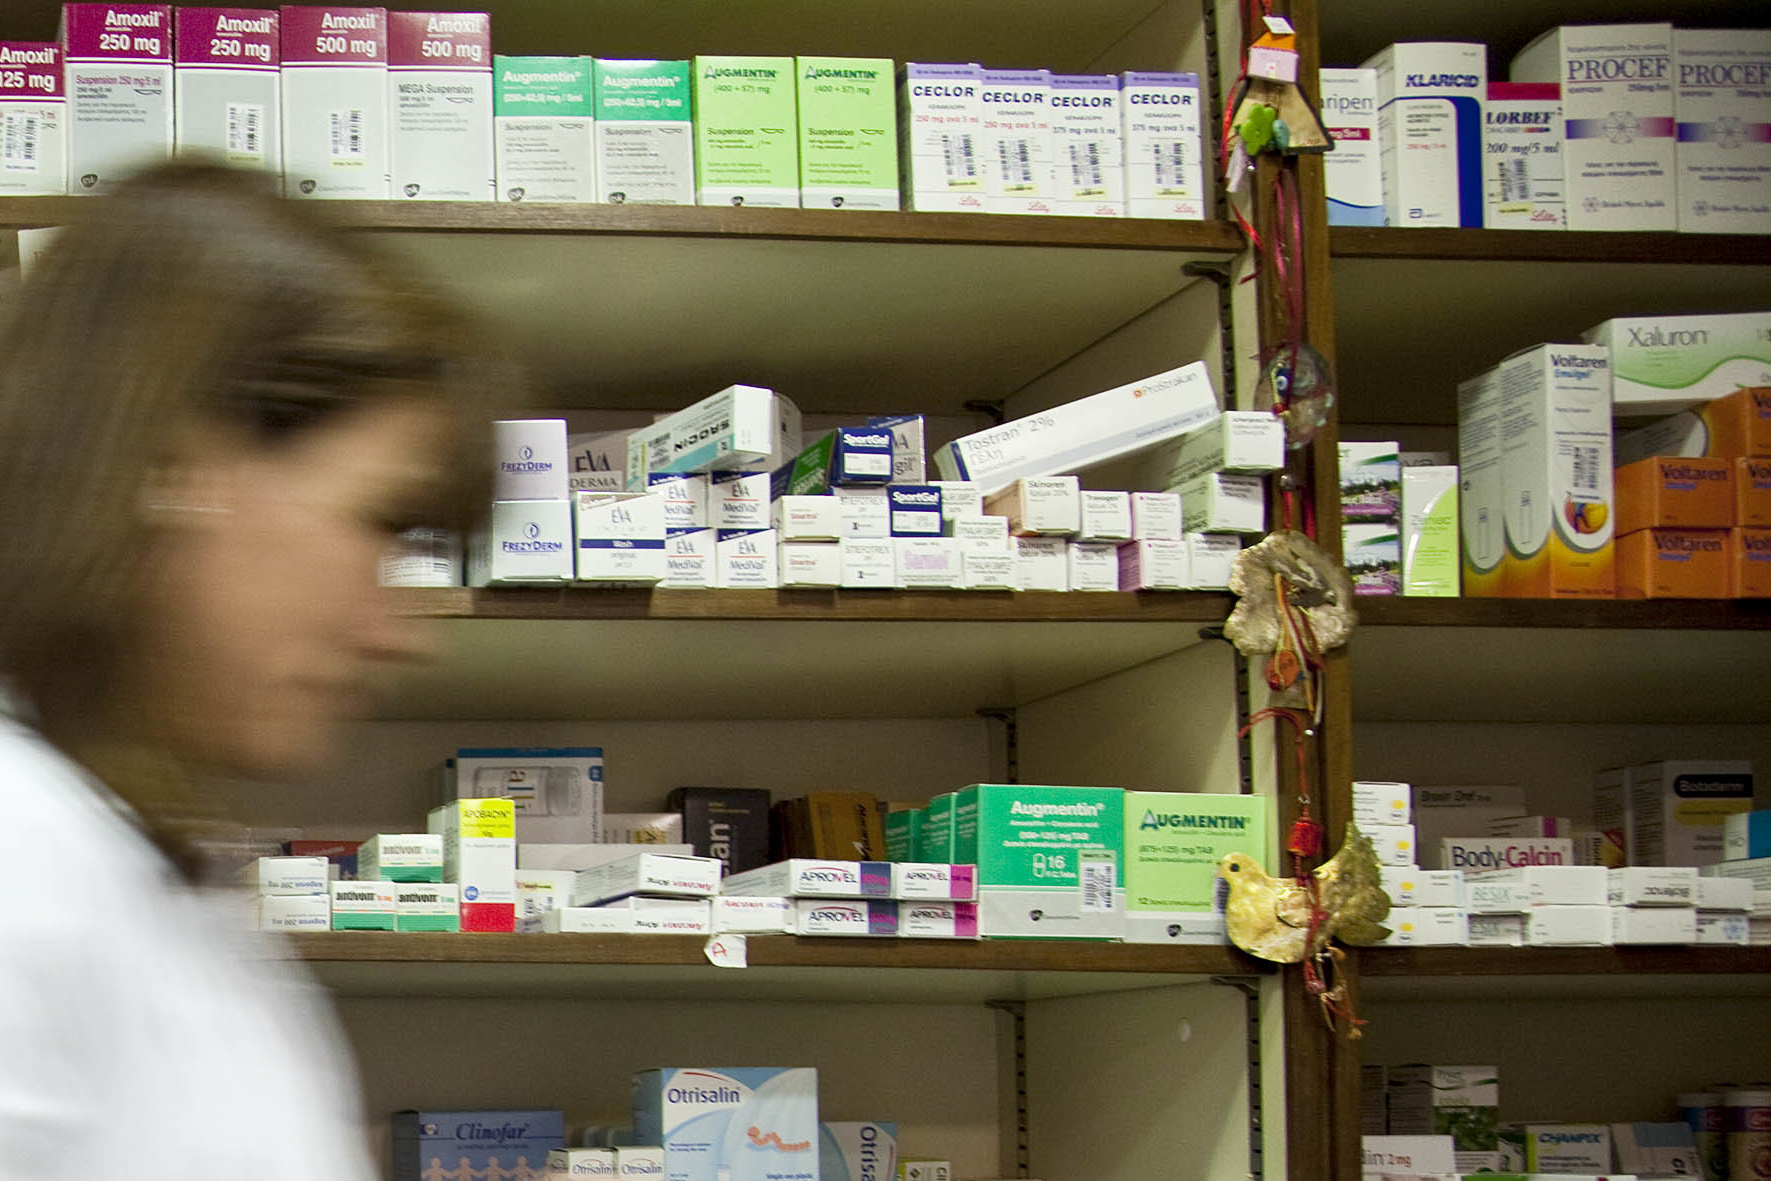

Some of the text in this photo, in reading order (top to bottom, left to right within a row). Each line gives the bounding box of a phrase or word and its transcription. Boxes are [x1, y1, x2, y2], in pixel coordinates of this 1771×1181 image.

[106, 9, 159, 28] Amoxil
[216, 15, 271, 35] Amoxil
[321, 13, 375, 31] Amoxil
[427, 17, 480, 35] Amoxil
[99, 33, 160, 55] 250 mg
[210, 38, 271, 60] 250 mg
[316, 37, 377, 58] 500 mg
[421, 40, 483, 62] 500 mg
[0, 46, 53, 66] Amoxil
[503, 71, 576, 83] Augmentin
[1566, 58, 1669, 80] PROCEF
[1679, 64, 1771, 86] PROCEF
[28, 73, 55, 93] mg
[603, 75, 676, 88] Augmentin
[1405, 73, 1479, 88] KLARICID
[913, 85, 974, 97] CECLOR
[982, 91, 1044, 103] CECLOR
[1130, 94, 1192, 105] CECLOR
[1051, 96, 1112, 107] CECLOR
[1628, 328, 1706, 346] Xaluron
[1550, 354, 1607, 369] Voltaren
[501, 462, 552, 473] FREZYDERM
[1660, 464, 1726, 481] Voltaren
[502, 541, 563, 552] FREZYDERM
[1654, 535, 1722, 552] Voltaren
[1010, 801, 1097, 817] Augmentin
[1140, 809, 1245, 829] AUGMENTIN
[1047, 856, 1064, 869] 16
[800, 871, 857, 884] APROVEL
[906, 872, 948, 881] APROVEL
[809, 911, 865, 922] APROVEL
[910, 910, 953, 919] APROVEL
[667, 1087, 740, 1105] Otrisalin
[455, 1123, 527, 1141] Clinofar
